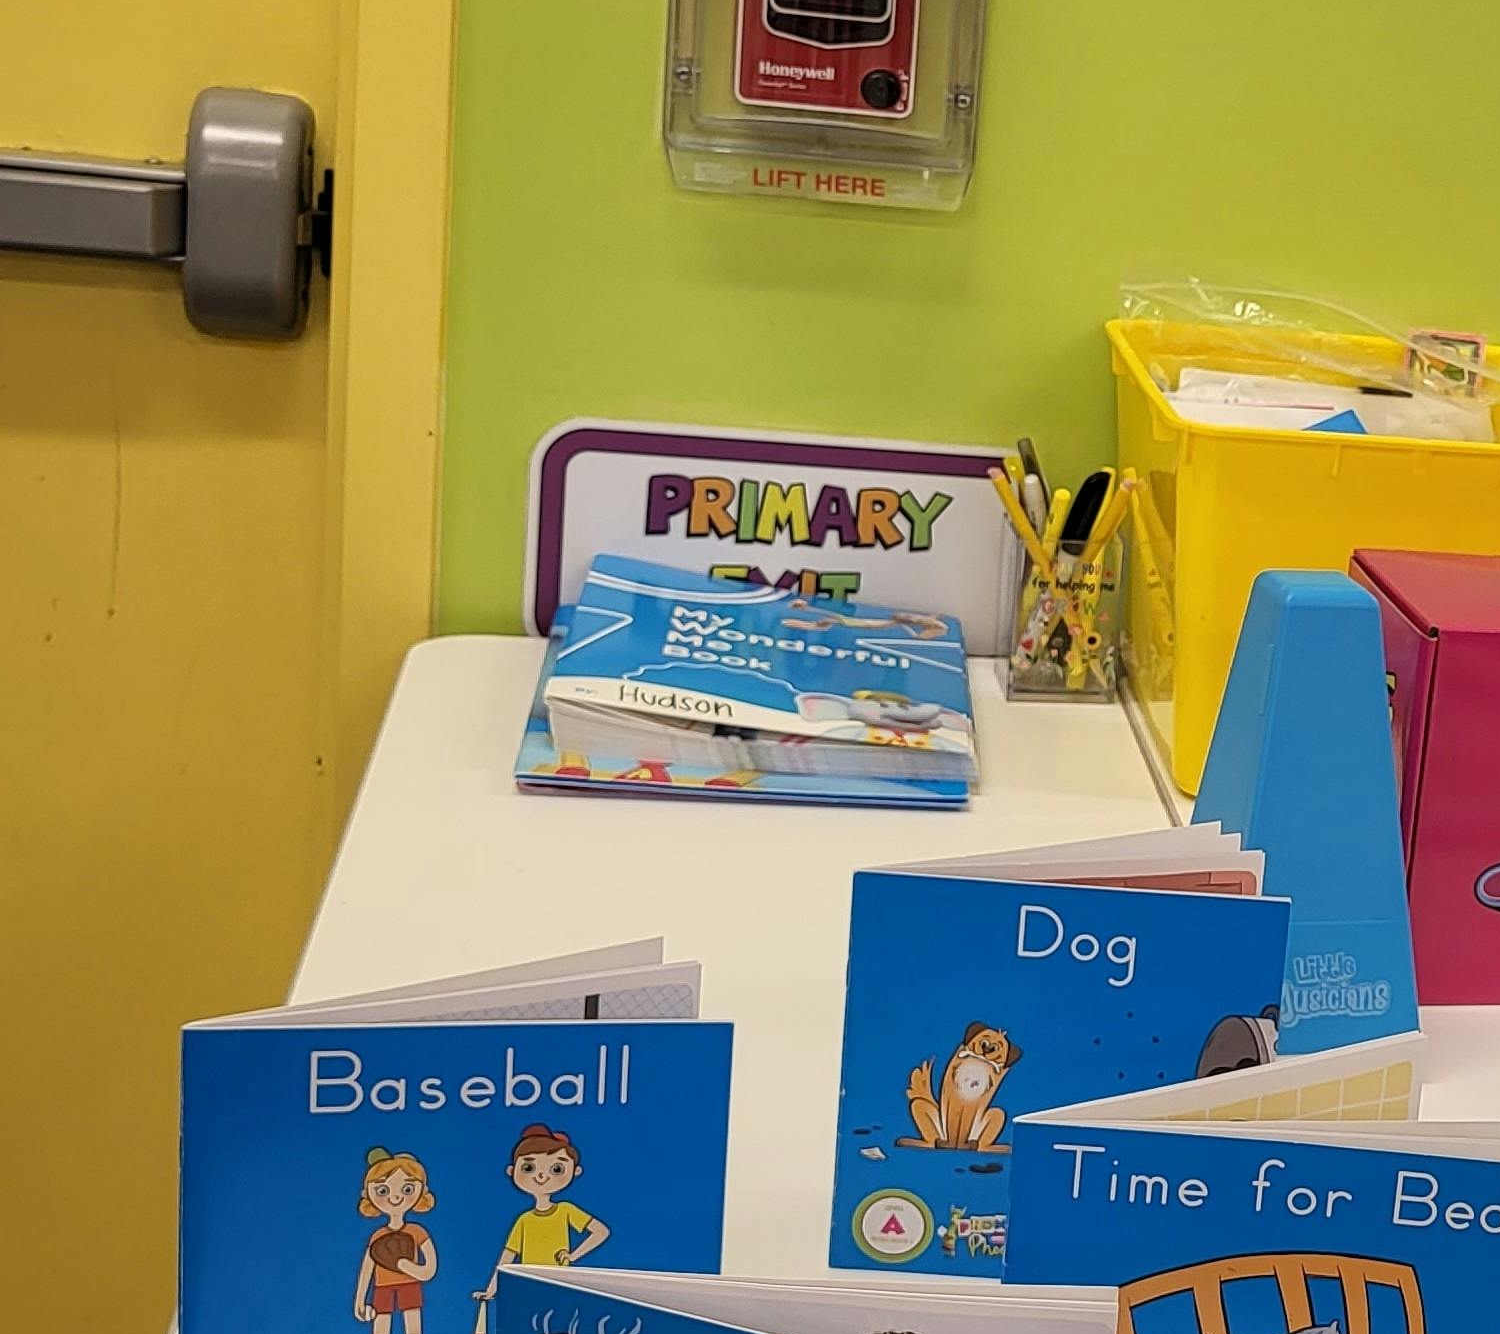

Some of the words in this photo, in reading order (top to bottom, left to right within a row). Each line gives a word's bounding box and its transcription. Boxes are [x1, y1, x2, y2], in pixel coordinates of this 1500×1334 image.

[758, 60, 835, 81] Honeywell
[753, 168, 807, 190] LIFT
[815, 173, 886, 198] HERE
[644, 473, 953, 551] PRIMARY
[1055, 578, 1096, 594] helping
[673, 605, 735, 628] My
[662, 643, 772, 672] Book
[669, 617, 912, 670] Wonderful
[618, 682, 736, 719] Hudson
[1015, 904, 1138, 987] Dog
[1293, 952, 1357, 983] Little
[308, 1044, 630, 1115] Baseball
[1052, 1142, 1209, 1208] Time
[1251, 1158, 1353, 1219] for
[879, 1212, 906, 1235] A
